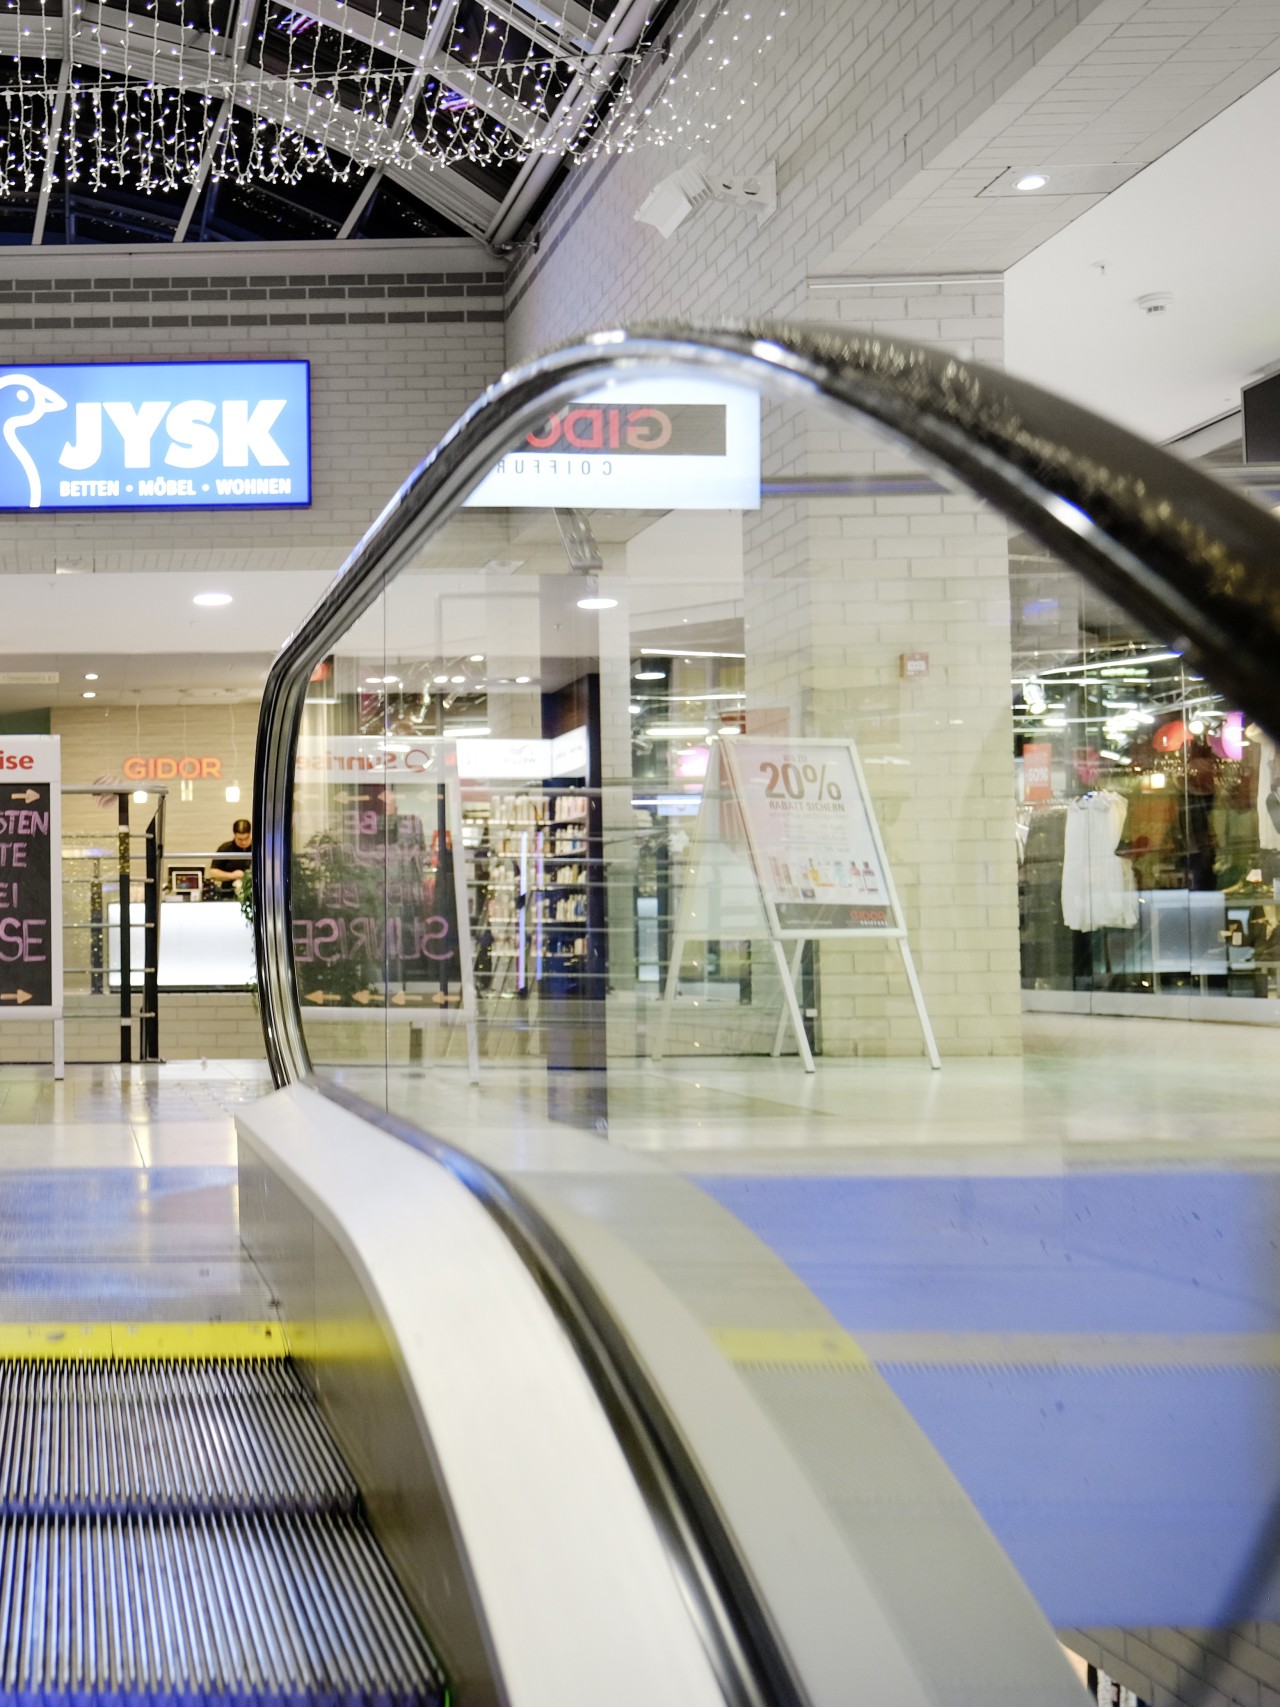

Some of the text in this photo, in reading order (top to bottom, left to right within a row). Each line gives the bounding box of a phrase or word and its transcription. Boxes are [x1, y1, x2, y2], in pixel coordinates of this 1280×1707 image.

[58, 399, 290, 470] JYSK
[59, 476, 292, 497] BETTEN MÖBEL WOHNEN
[122, 755, 222, 781] GIDOR
[759, 761, 842, 801] 20%
